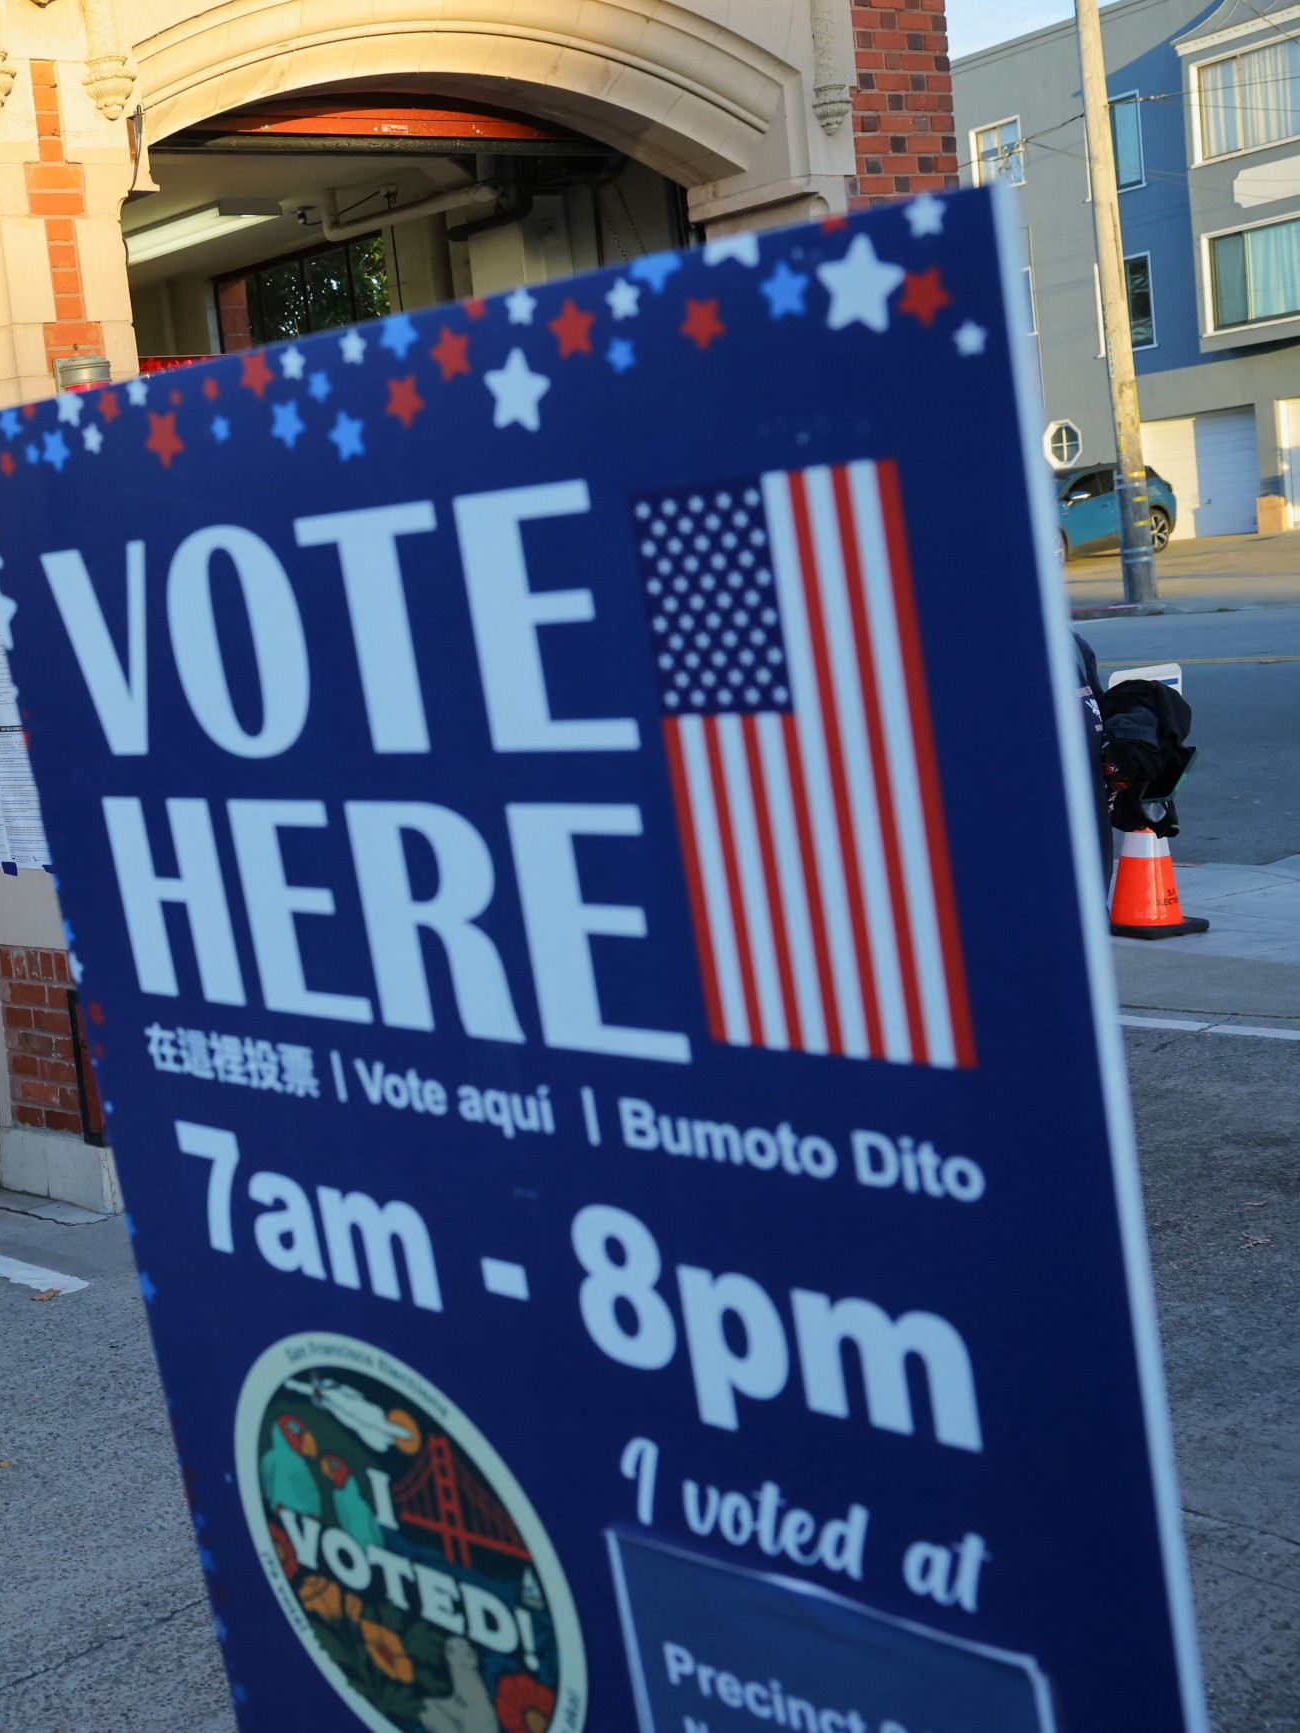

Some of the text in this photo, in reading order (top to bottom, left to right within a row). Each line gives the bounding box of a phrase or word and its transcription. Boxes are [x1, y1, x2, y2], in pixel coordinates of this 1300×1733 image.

[41, 482, 639, 758] VOTE
[103, 797, 690, 1063] HERE
[144, 1022, 320, 1098] 在這裡投票
[354, 1059, 448, 1116] Vote
[458, 1085, 555, 1139] aquí
[619, 1097, 838, 1178] Bumoto
[851, 1131, 985, 1201] Dito
[176, 1121, 442, 1312] 7am
[572, 1205, 983, 1454] 8pm
[366, 1466, 400, 1532] I
[621, 1438, 992, 1612] I voted at
[277, 1505, 538, 1672] VOTED!
[663, 1641, 868, 1733] Precinct
